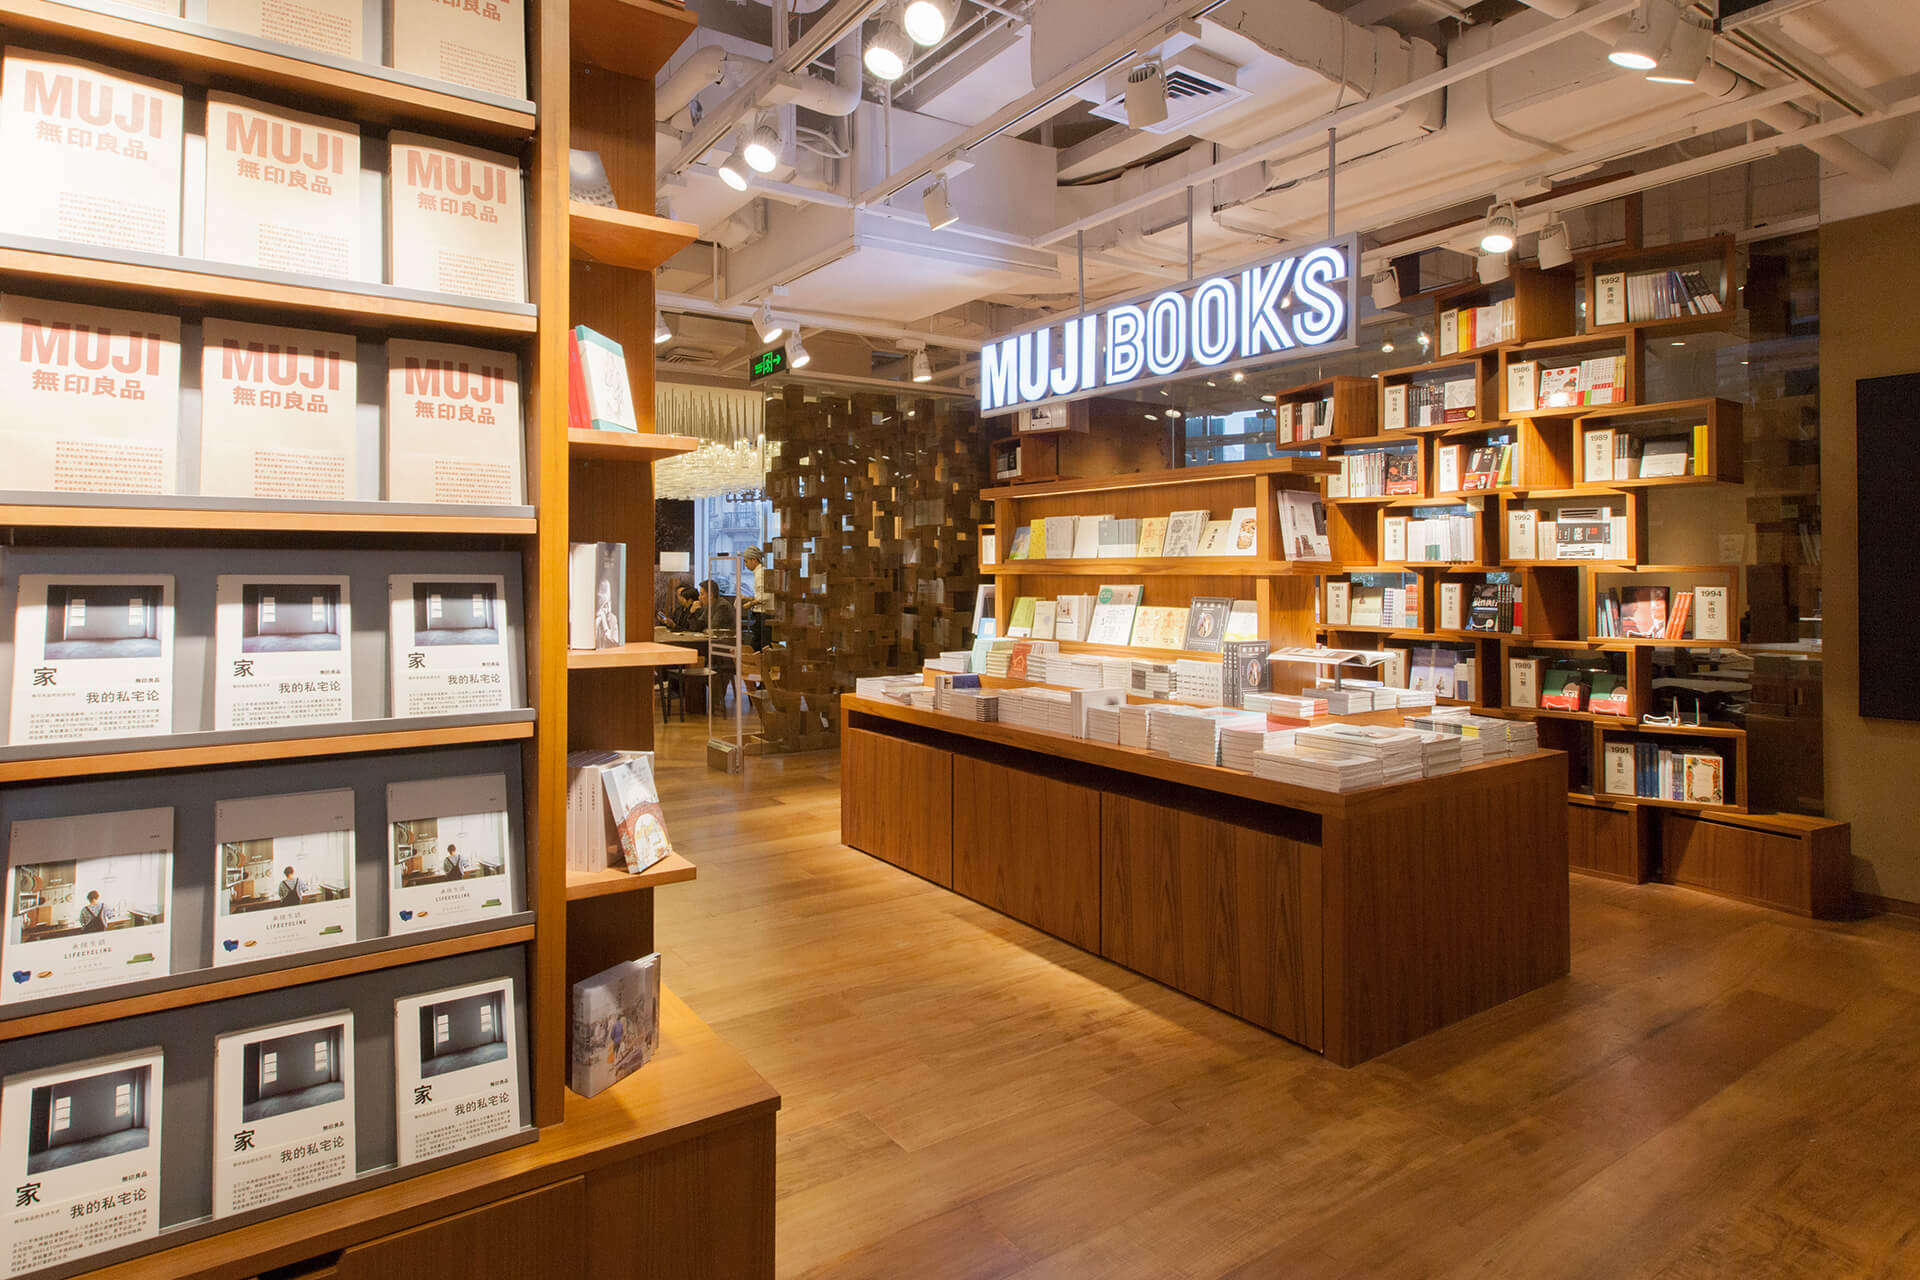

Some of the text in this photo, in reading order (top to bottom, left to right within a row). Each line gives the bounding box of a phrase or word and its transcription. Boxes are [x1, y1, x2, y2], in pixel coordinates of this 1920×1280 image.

[431, 0, 501, 22] 良品
[23, 69, 164, 139] MUJI
[35, 119, 149, 161] 無印良品
[225, 112, 344, 174] MUJI
[236, 158, 333, 196] 無印良品
[406, 150, 508, 204] MUJI
[417, 191, 499, 224] 無印良品
[1600, 276, 1621, 285] 1992
[980, 246, 1345, 412] MUJI BOOKS
[19, 318, 161, 376] MUJI
[221, 338, 340, 391] MUJI
[32, 369, 146, 400] 無印良品
[404, 356, 504, 404] MUJI
[232, 385, 329, 414] 無印良品
[414, 400, 496, 425] 無印良品
[1701, 589, 1722, 598] 1994
[232, 659, 255, 678] 家
[407, 652, 426, 669] 家
[32, 667, 57, 687] 家
[279, 680, 342, 694] 我的私宅论
[447, 673, 501, 686] 我的私宅论
[86, 689, 160, 704] 我的私宅论
[1611, 746, 1629, 754] 1991
[414, 1085, 433, 1105] 家
[454, 1092, 510, 1116] 我的私宅论
[234, 1129, 255, 1152] 家
[280, 1135, 345, 1163] 我的私宅论
[16, 1182, 41, 1208] 家
[70, 1188, 147, 1219] 我的私宅论
